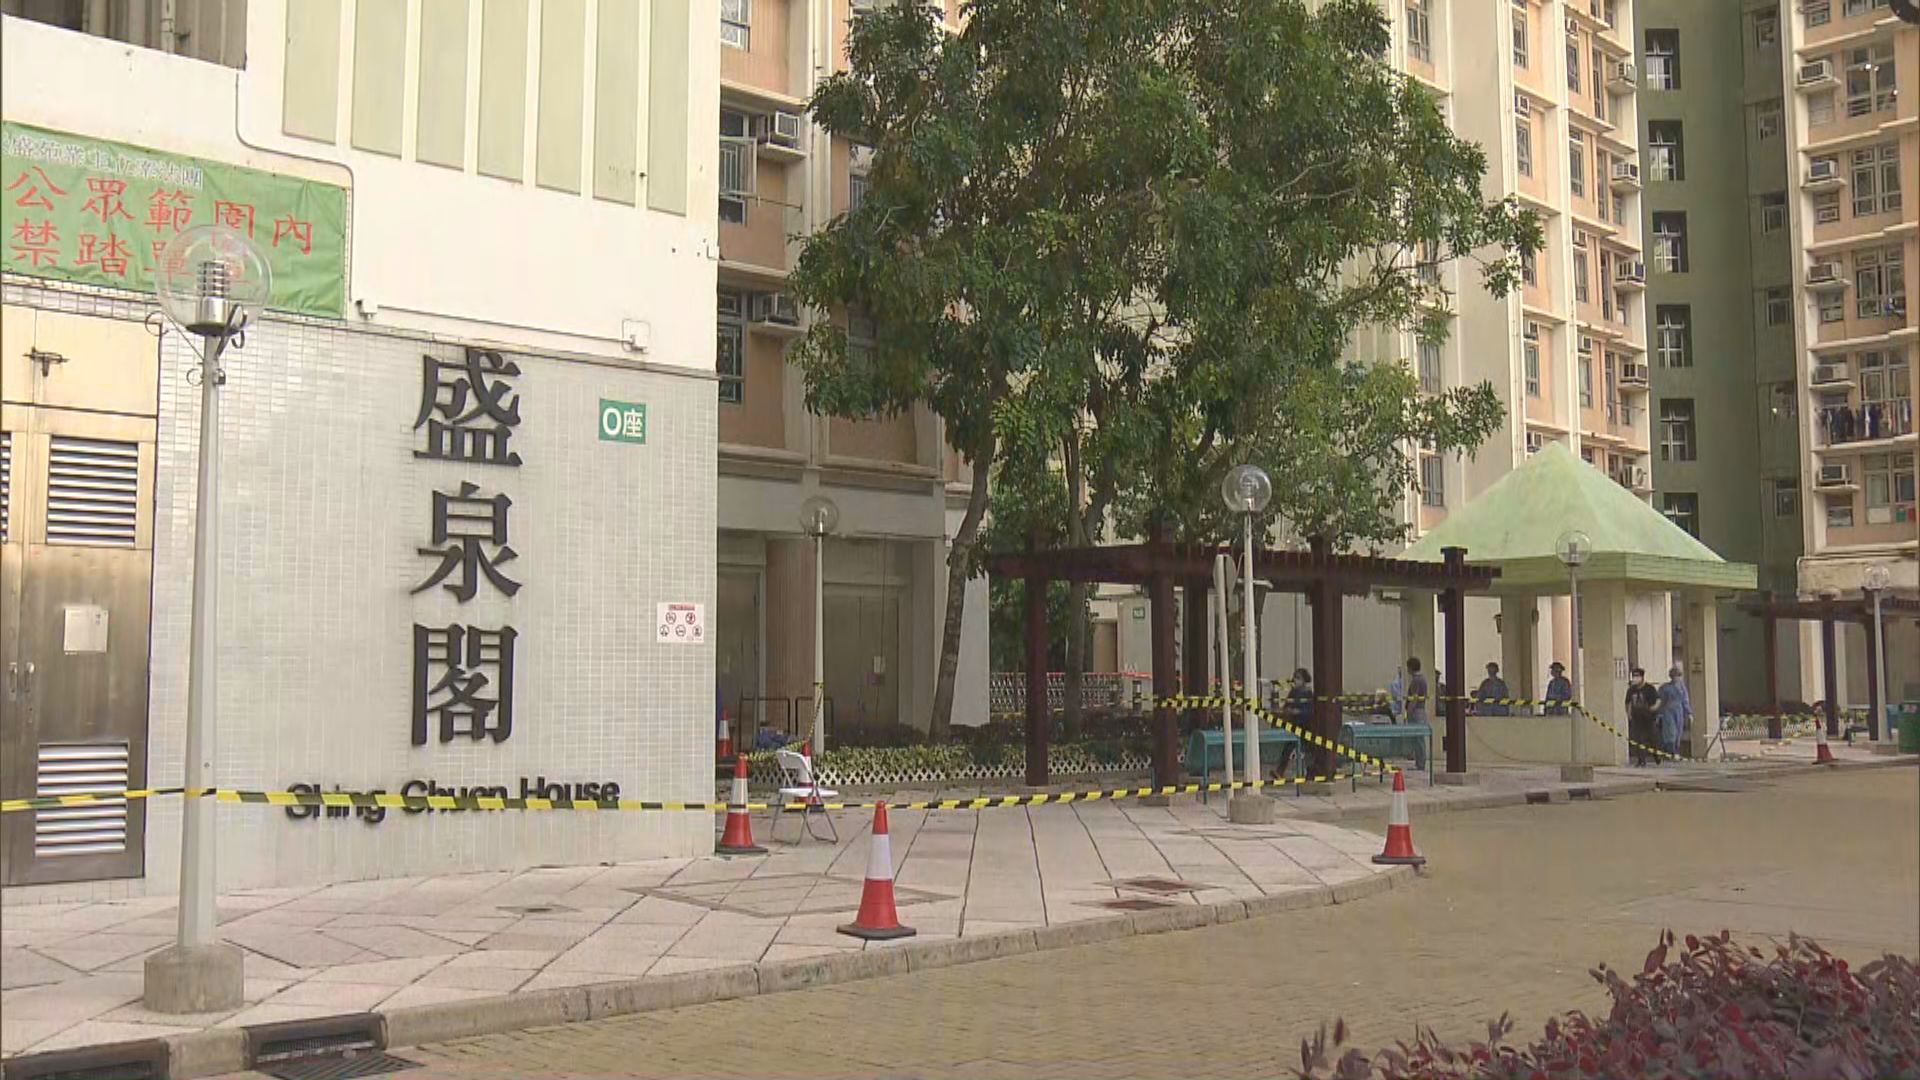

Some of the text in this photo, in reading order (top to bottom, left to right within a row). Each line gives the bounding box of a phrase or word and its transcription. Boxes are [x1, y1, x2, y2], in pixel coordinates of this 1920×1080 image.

[603, 408, 643, 437] O座
[411, 348, 523, 746] 盛泉閣
[286, 784, 387, 823] Shing
[520, 776, 621, 809] House
